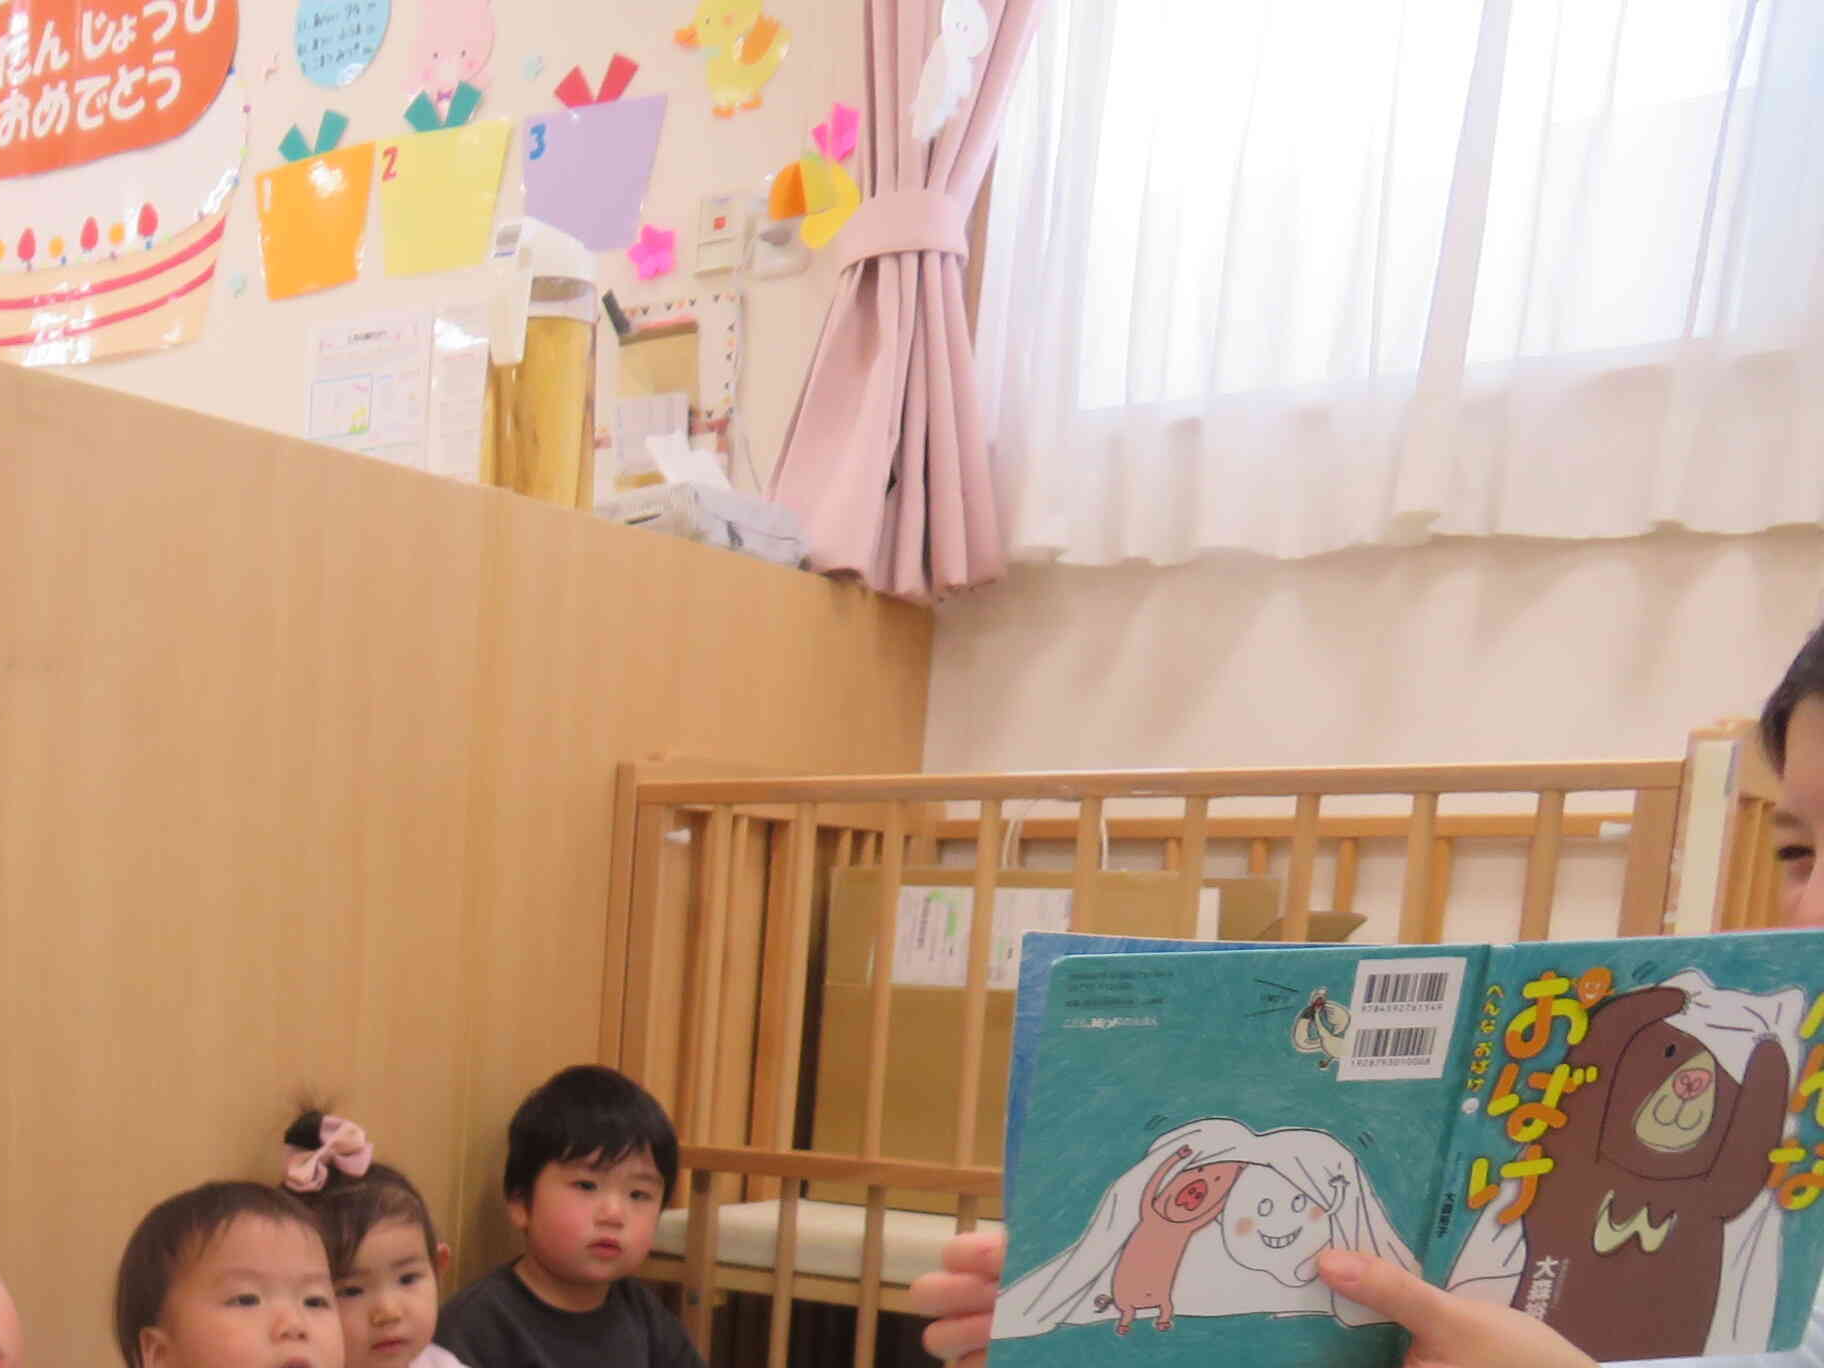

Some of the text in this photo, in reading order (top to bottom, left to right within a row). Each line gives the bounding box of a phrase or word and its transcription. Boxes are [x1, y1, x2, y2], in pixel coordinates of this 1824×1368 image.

[528, 122, 548, 161] 3
[382, 146, 399, 182] 2
[1466, 1041, 1494, 1091] おばけ
[1467, 970, 1599, 1226] おばけ
